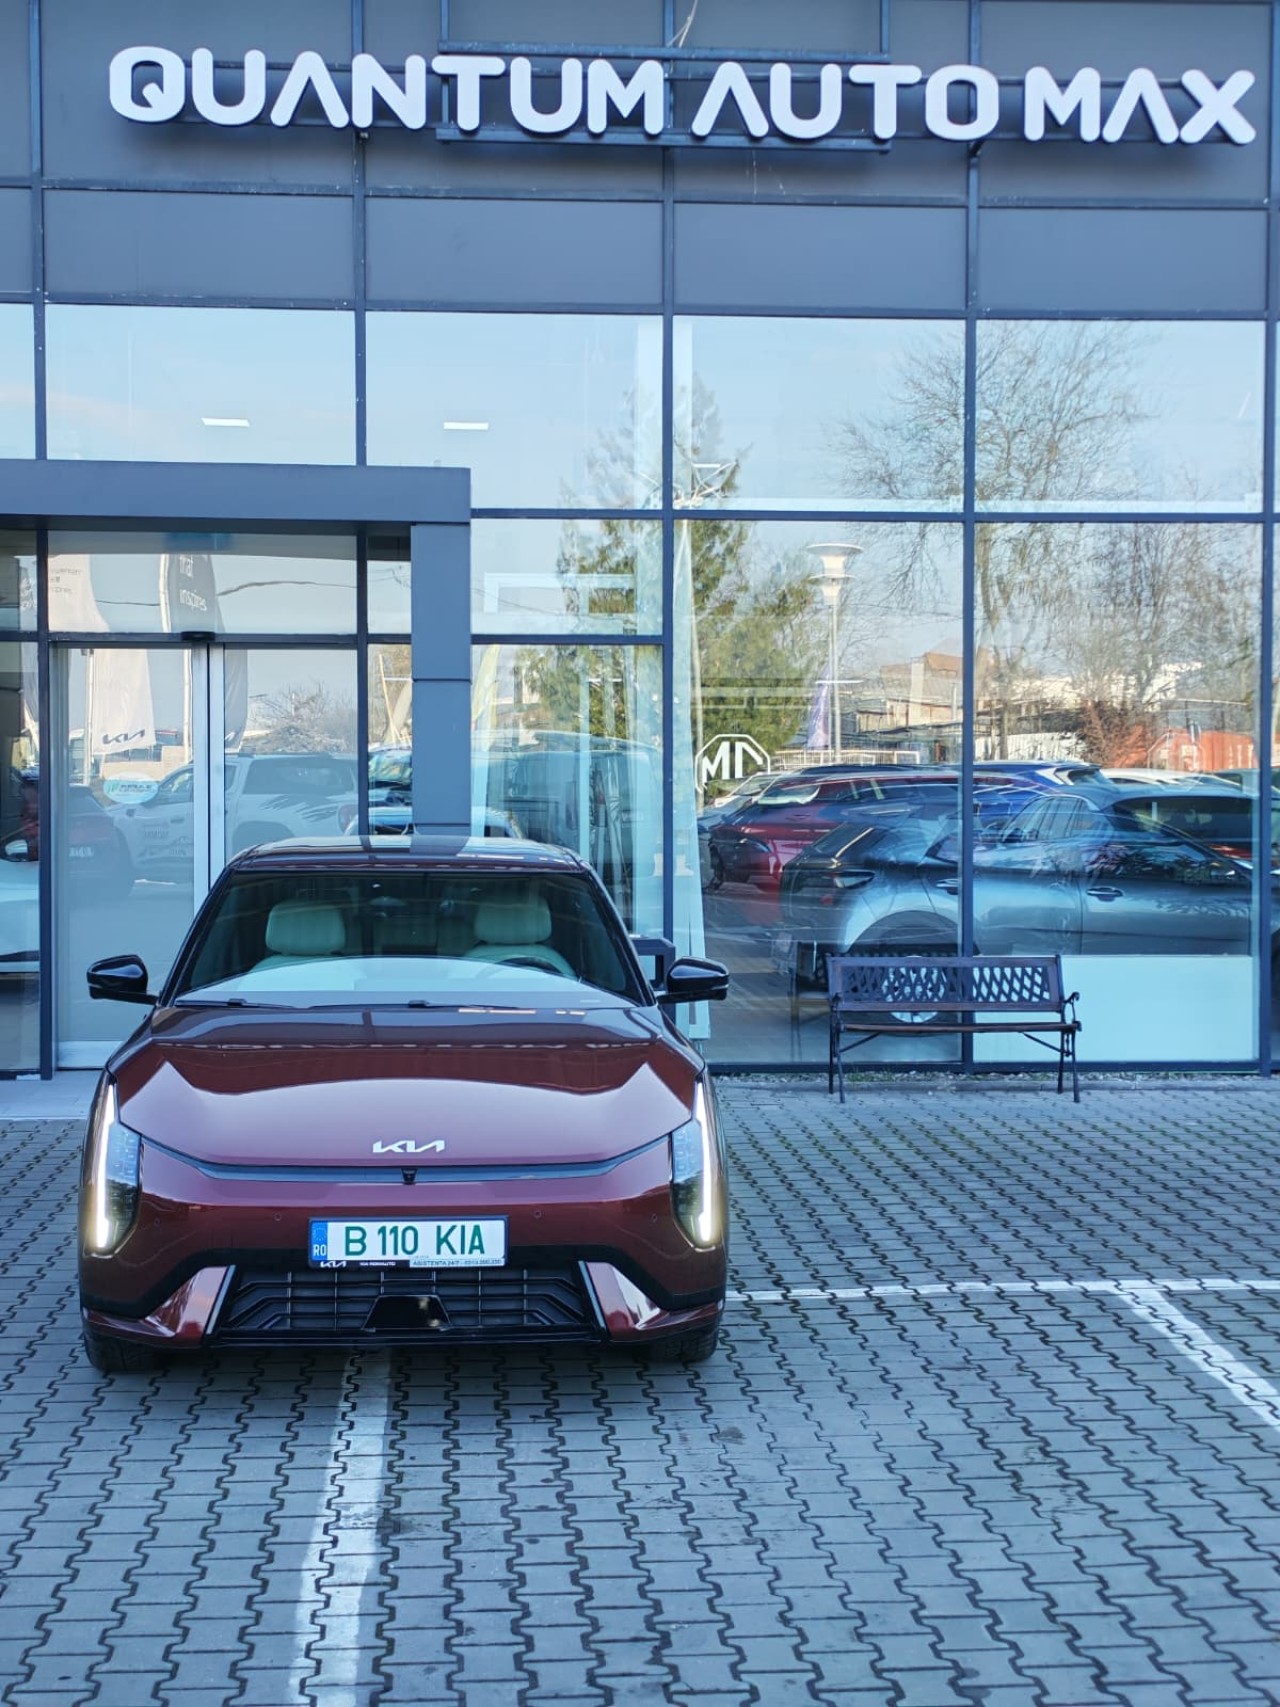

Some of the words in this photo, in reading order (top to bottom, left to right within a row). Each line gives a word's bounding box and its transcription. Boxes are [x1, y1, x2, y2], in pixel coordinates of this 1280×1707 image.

[109, 45, 664, 135] QUANTUM
[691, 60, 999, 142] AUTO
[1023, 66, 1256, 145] MAX
[102, 729, 146, 744] KIA
[372, 1139, 445, 1153] KIA
[345, 1226, 367, 1256] B
[377, 1225, 419, 1256] 110
[436, 1224, 485, 1255] KIA
[313, 1244, 326, 1256] RO
[320, 1260, 347, 1268] KIA
